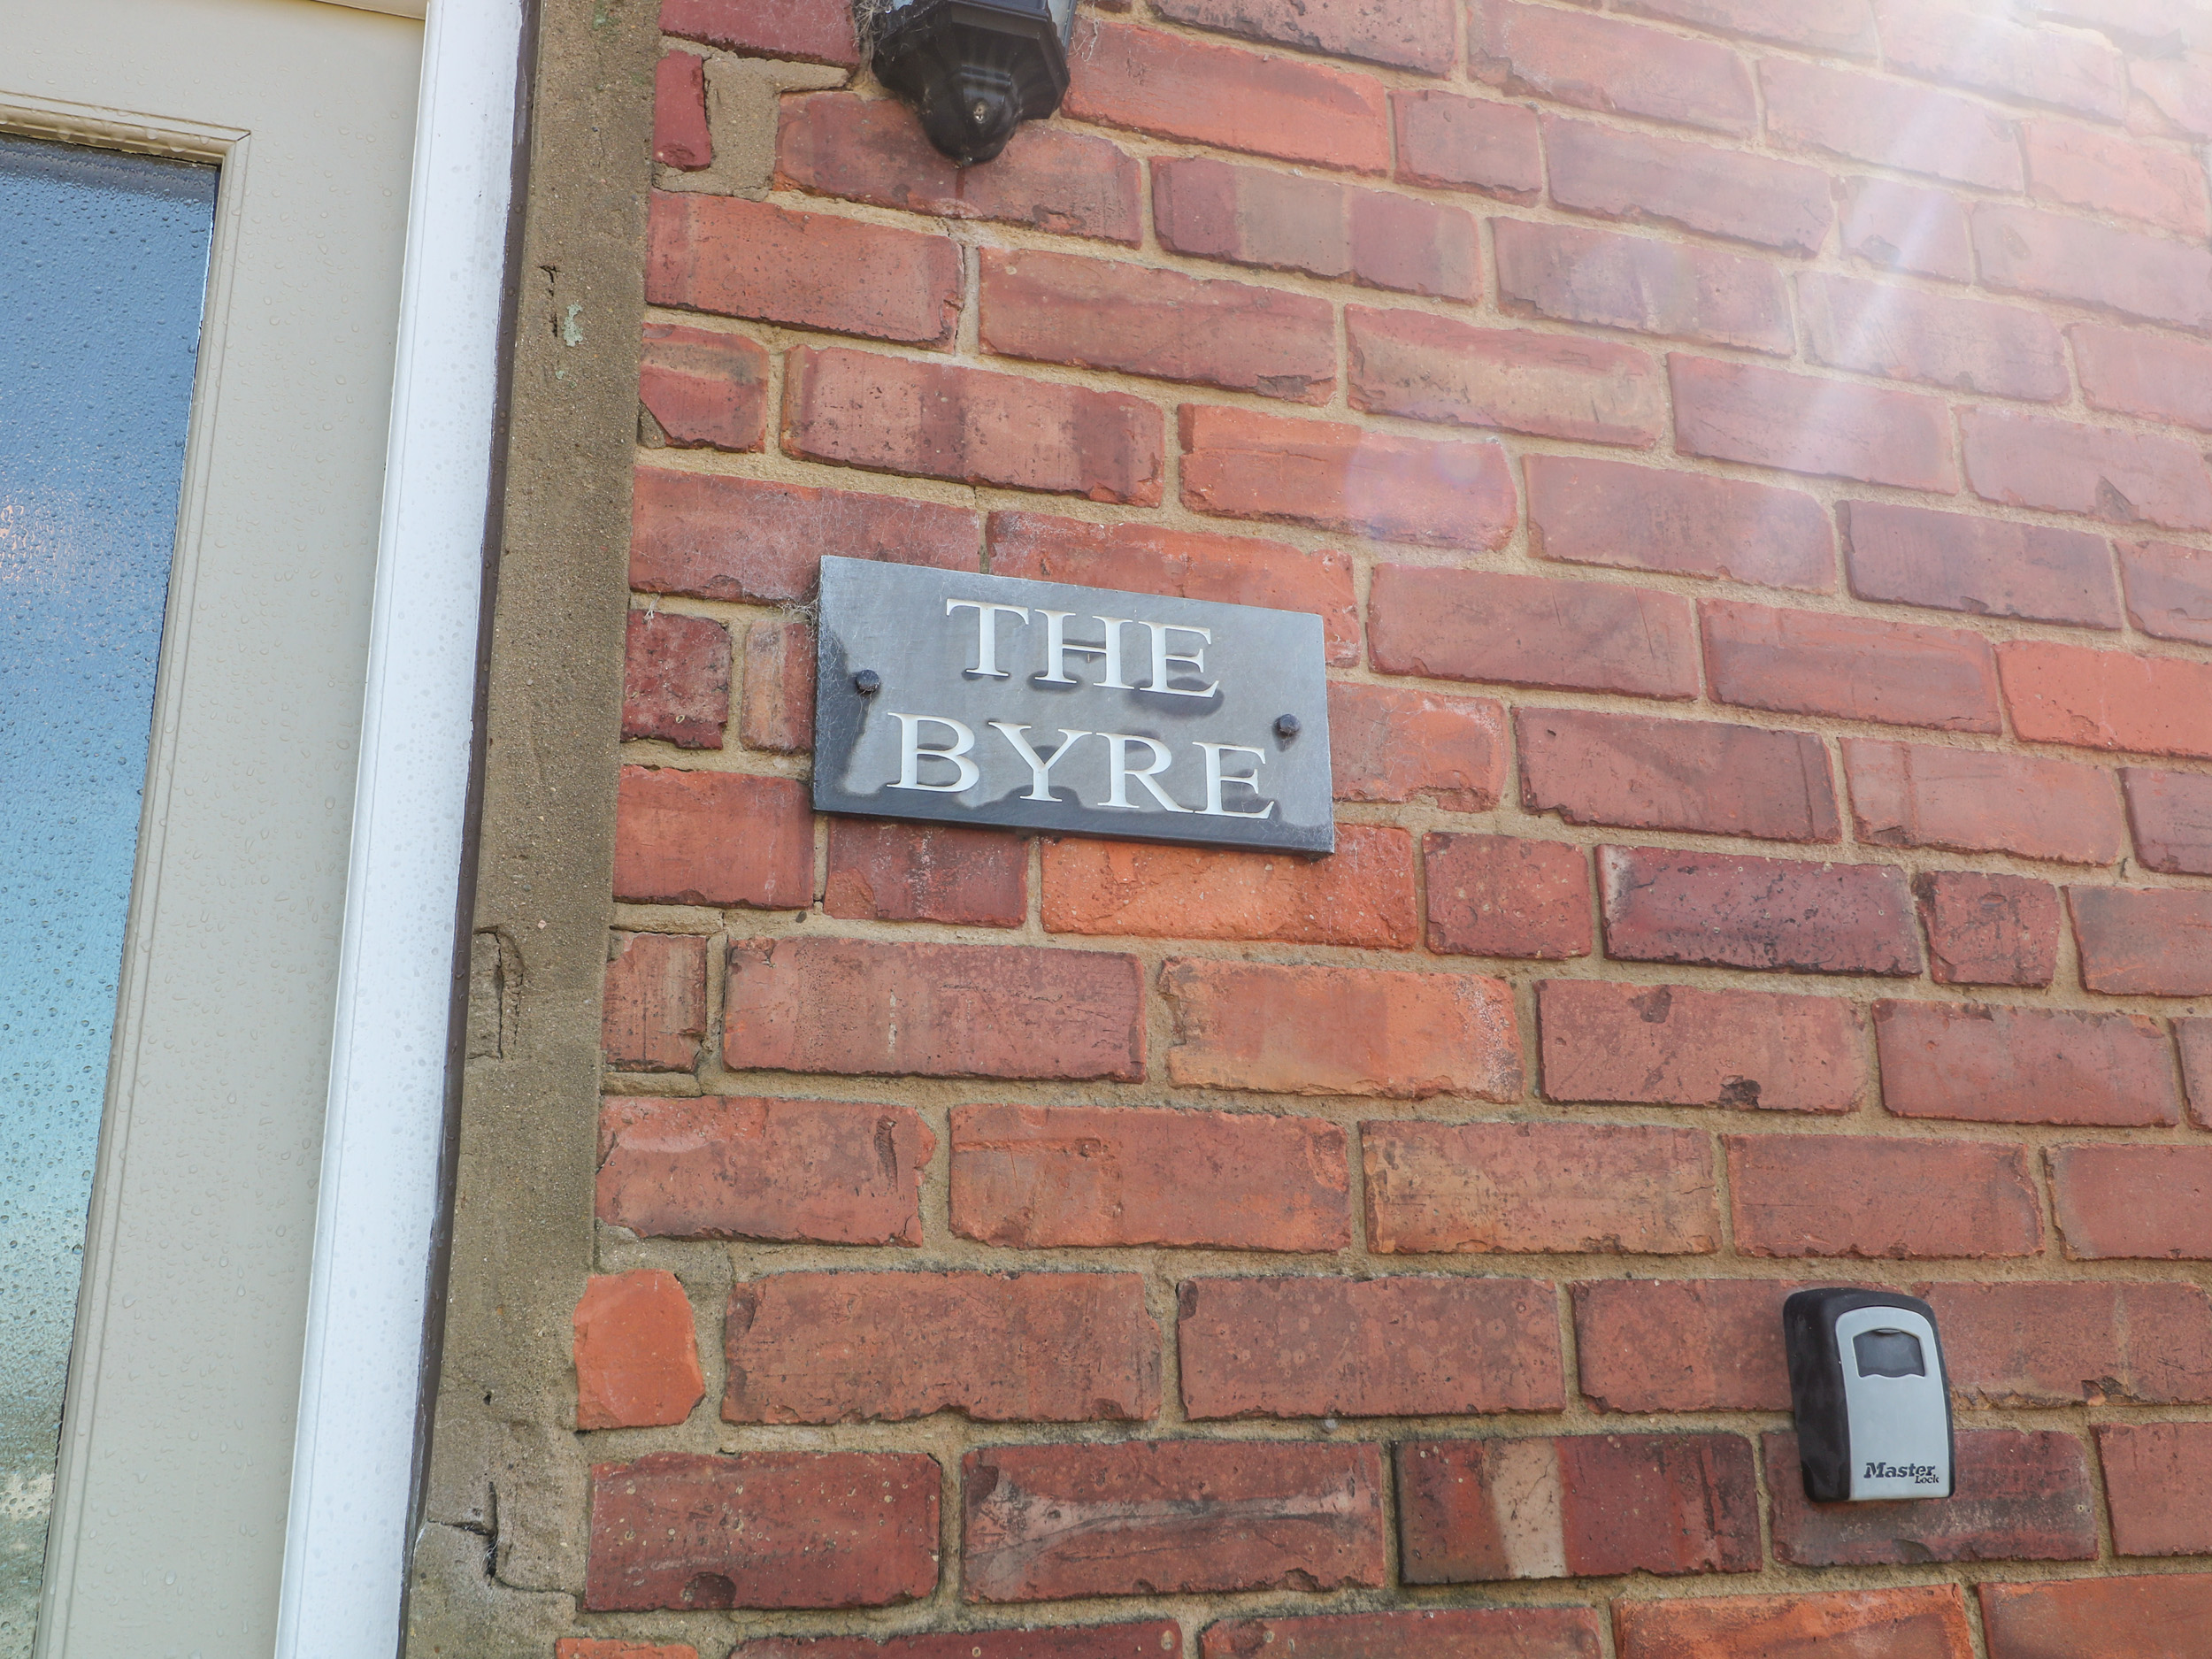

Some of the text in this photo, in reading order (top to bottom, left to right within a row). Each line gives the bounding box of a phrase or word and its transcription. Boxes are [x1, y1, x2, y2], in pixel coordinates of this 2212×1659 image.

[945, 597, 1220, 699] THE
[886, 711, 1275, 819] BYRE
[1863, 1462, 1936, 1479] Master
[1914, 1474, 1939, 1484] Lock
